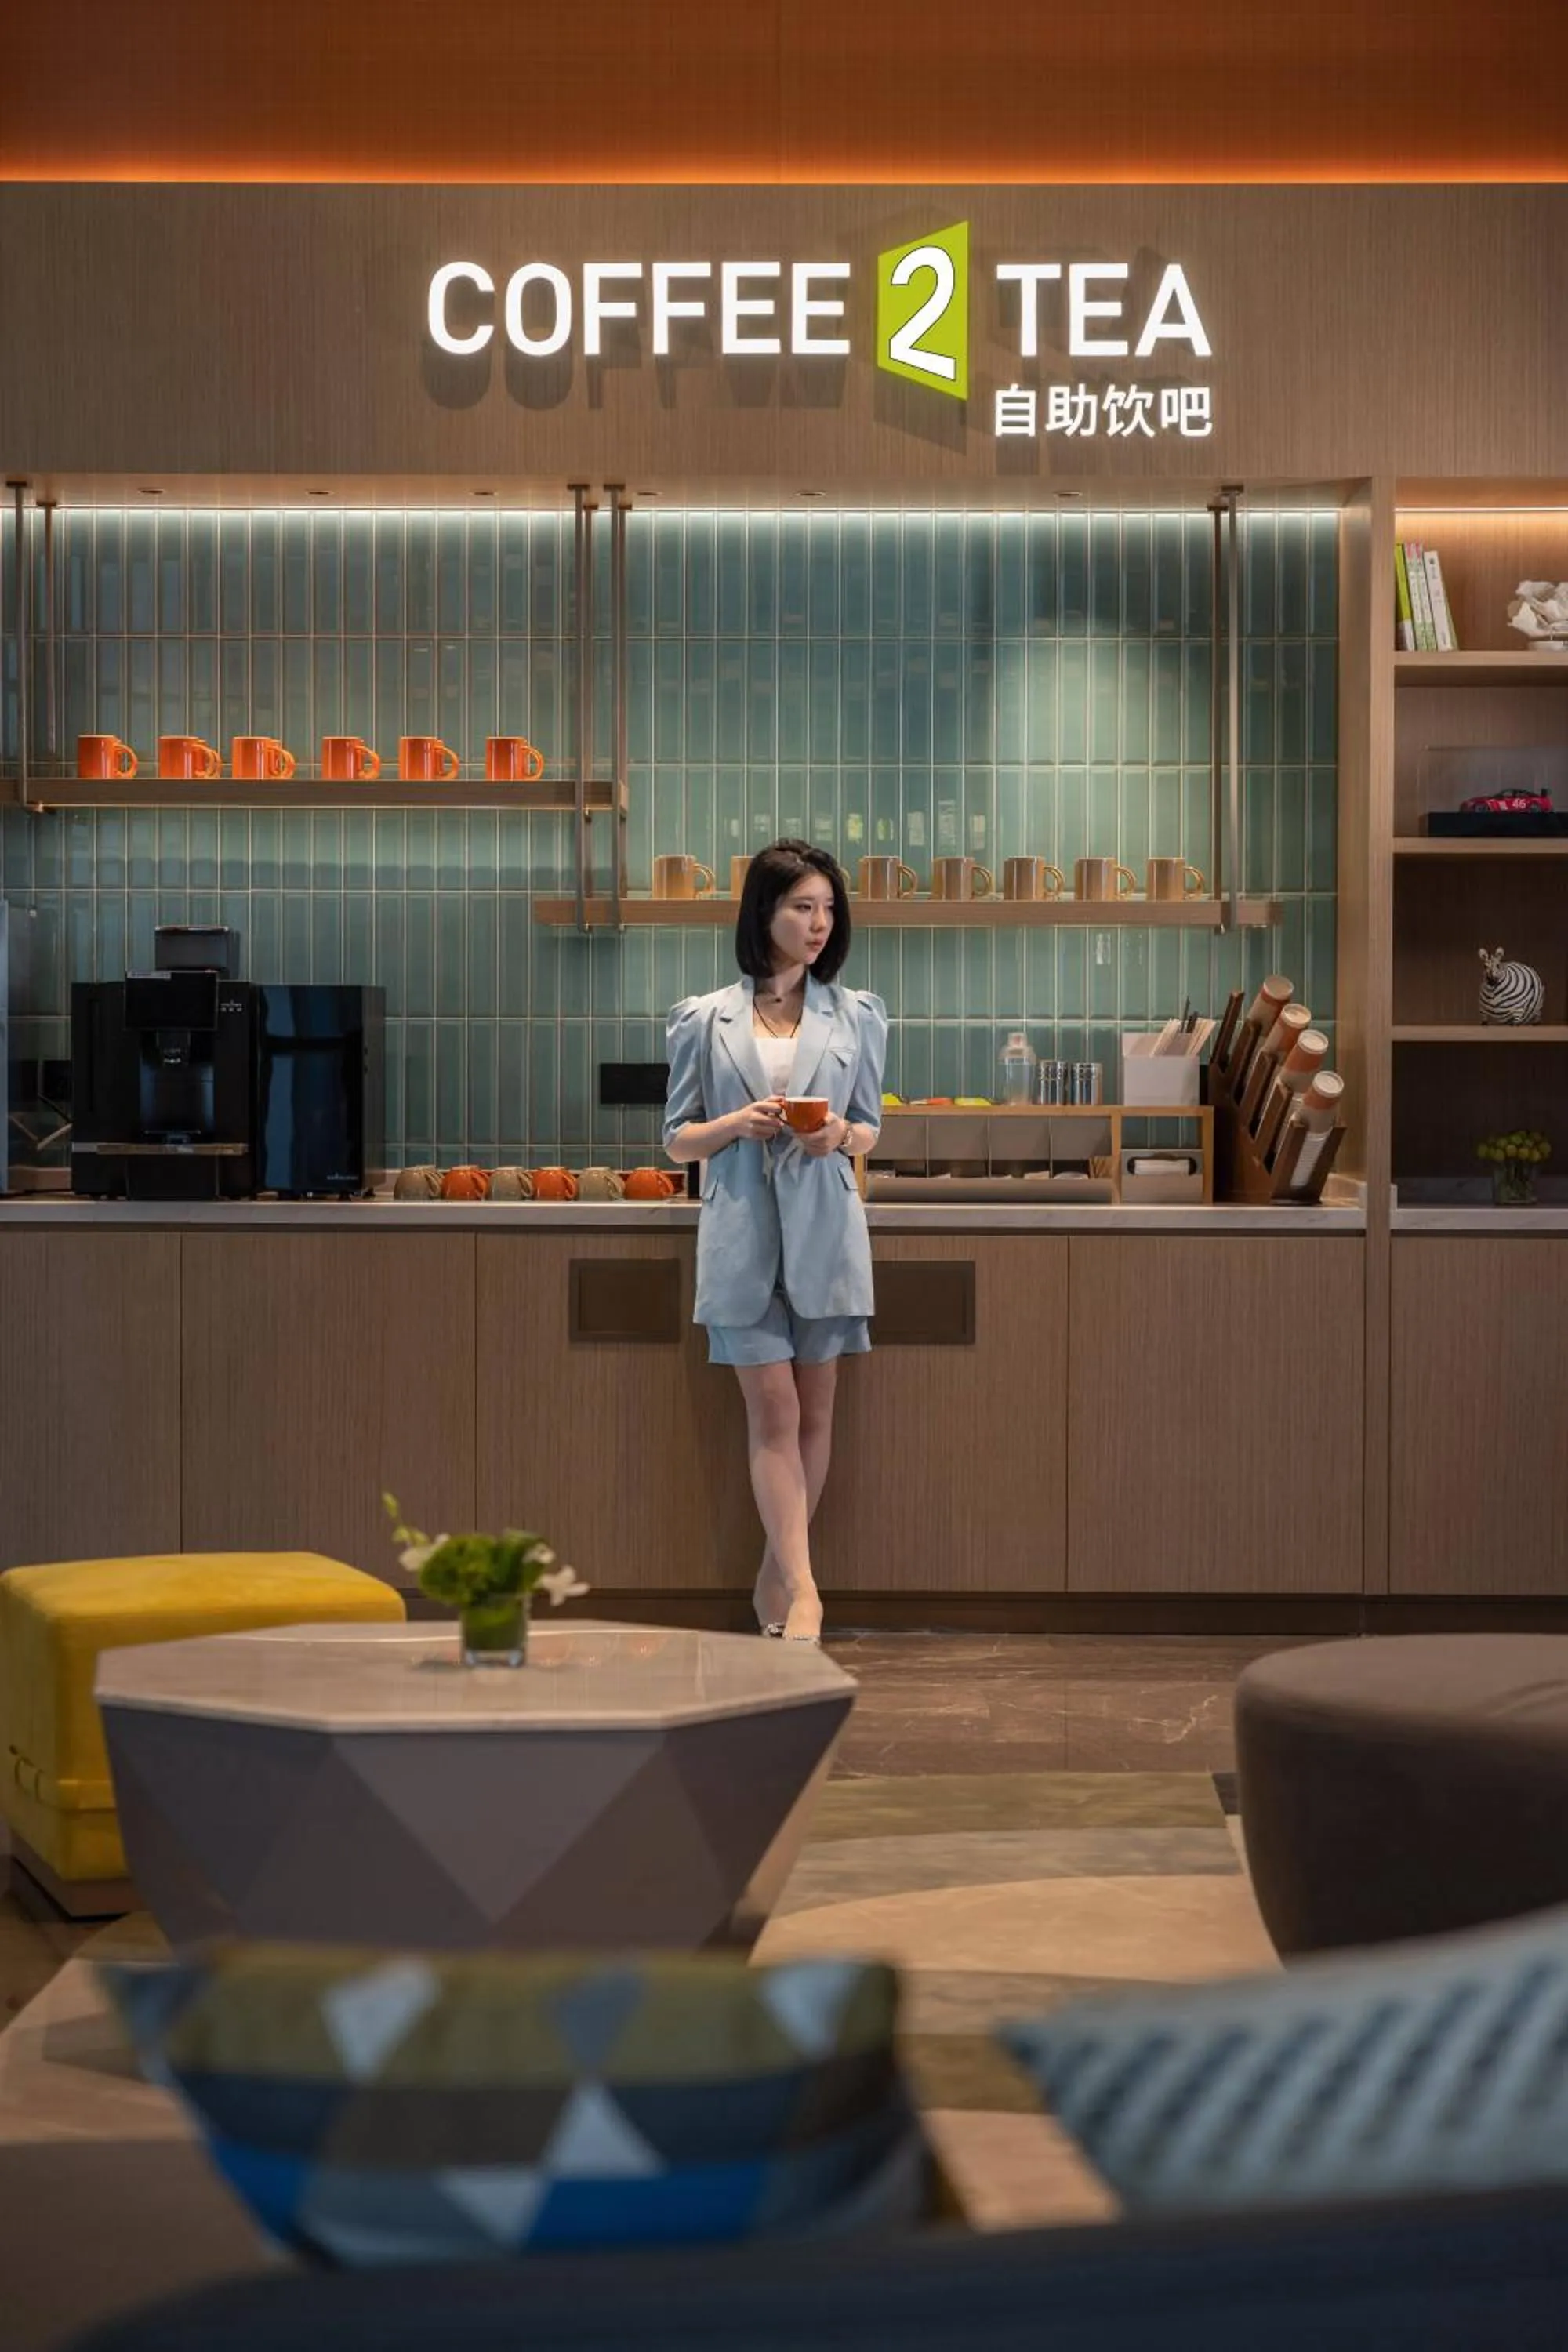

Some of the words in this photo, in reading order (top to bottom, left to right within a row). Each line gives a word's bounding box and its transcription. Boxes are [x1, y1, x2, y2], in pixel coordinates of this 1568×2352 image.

[428, 261, 850, 356] COFFEE
[890, 246, 954, 379] 2
[996, 263, 1212, 357] TEA
[994, 383, 1213, 437] 自助饮吧
